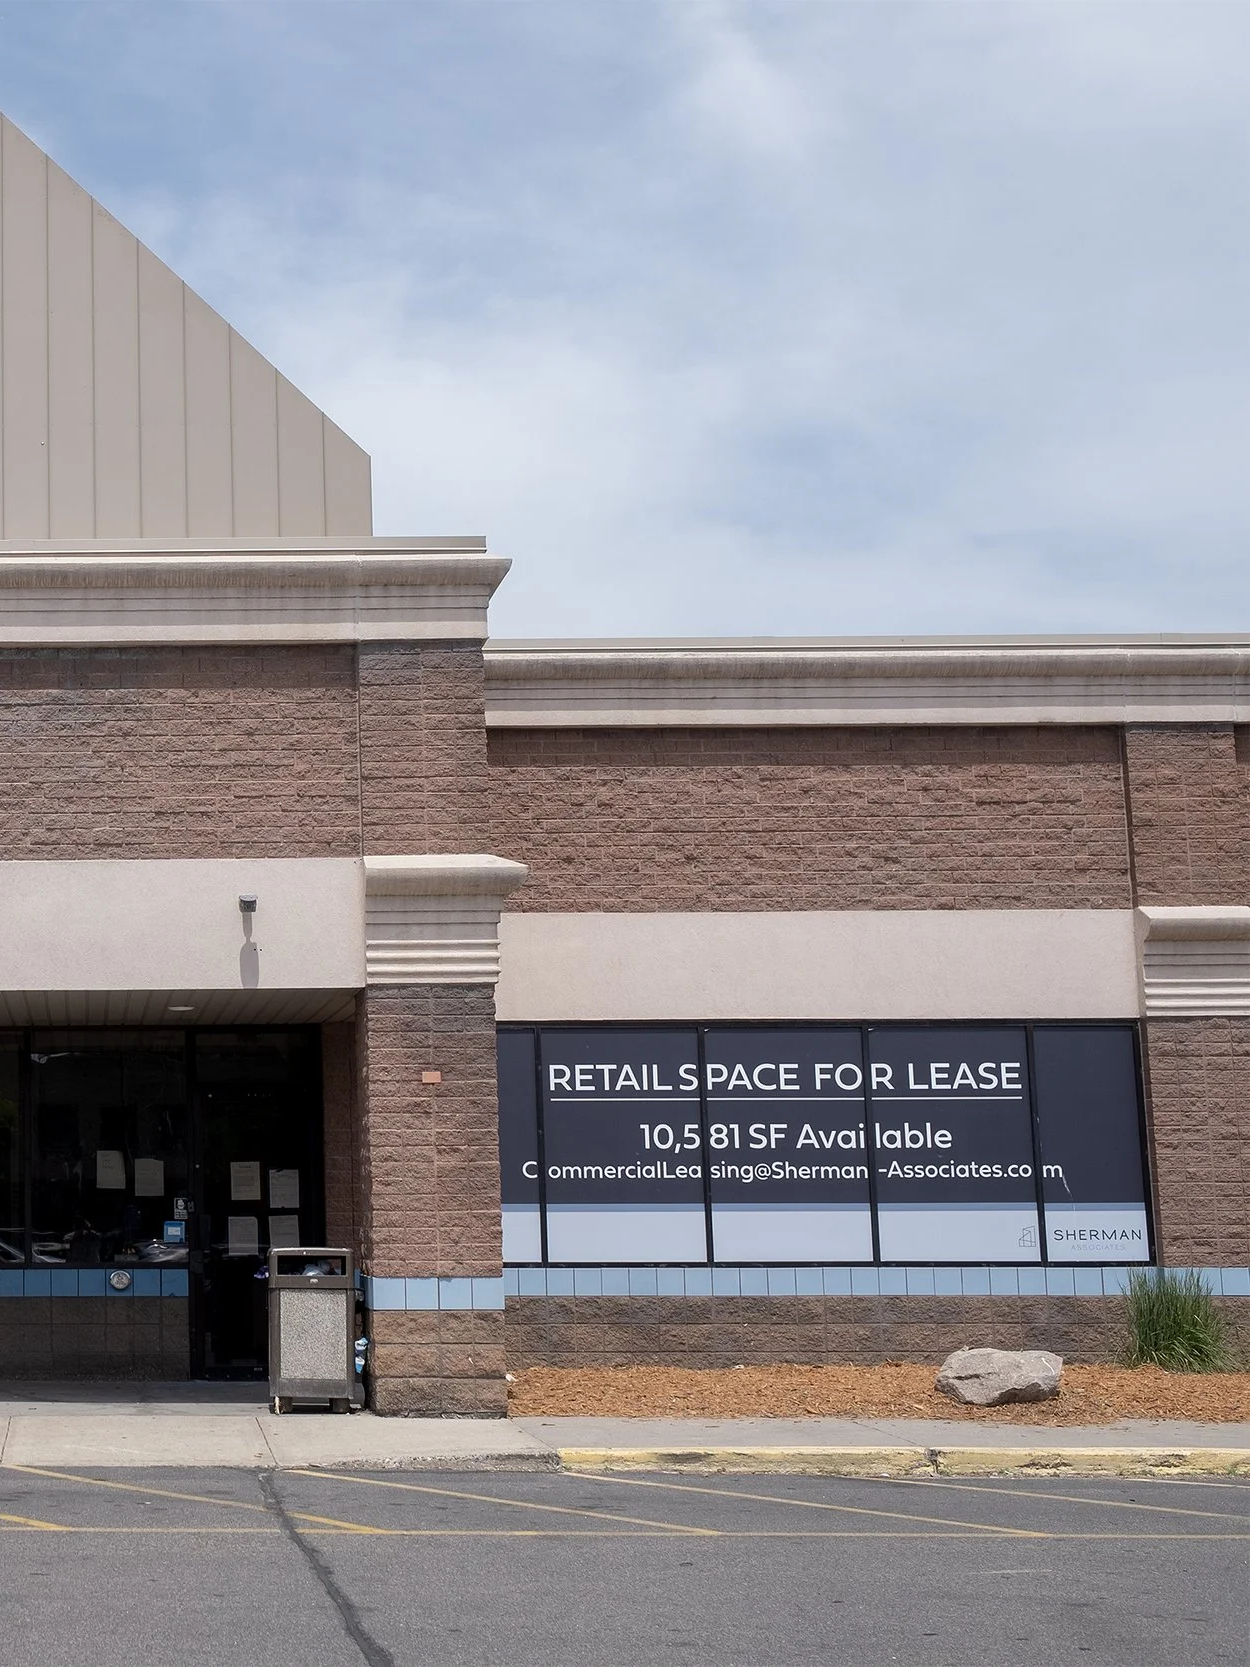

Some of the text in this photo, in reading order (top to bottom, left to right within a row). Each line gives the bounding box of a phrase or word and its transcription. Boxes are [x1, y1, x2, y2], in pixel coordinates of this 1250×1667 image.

[549, 1062, 1022, 1091] RETAIL SPACE FOR LEASE
[639, 1123, 952, 1153] 10,581 SF Available
[1053, 1229, 1142, 1242] SHERMAN
